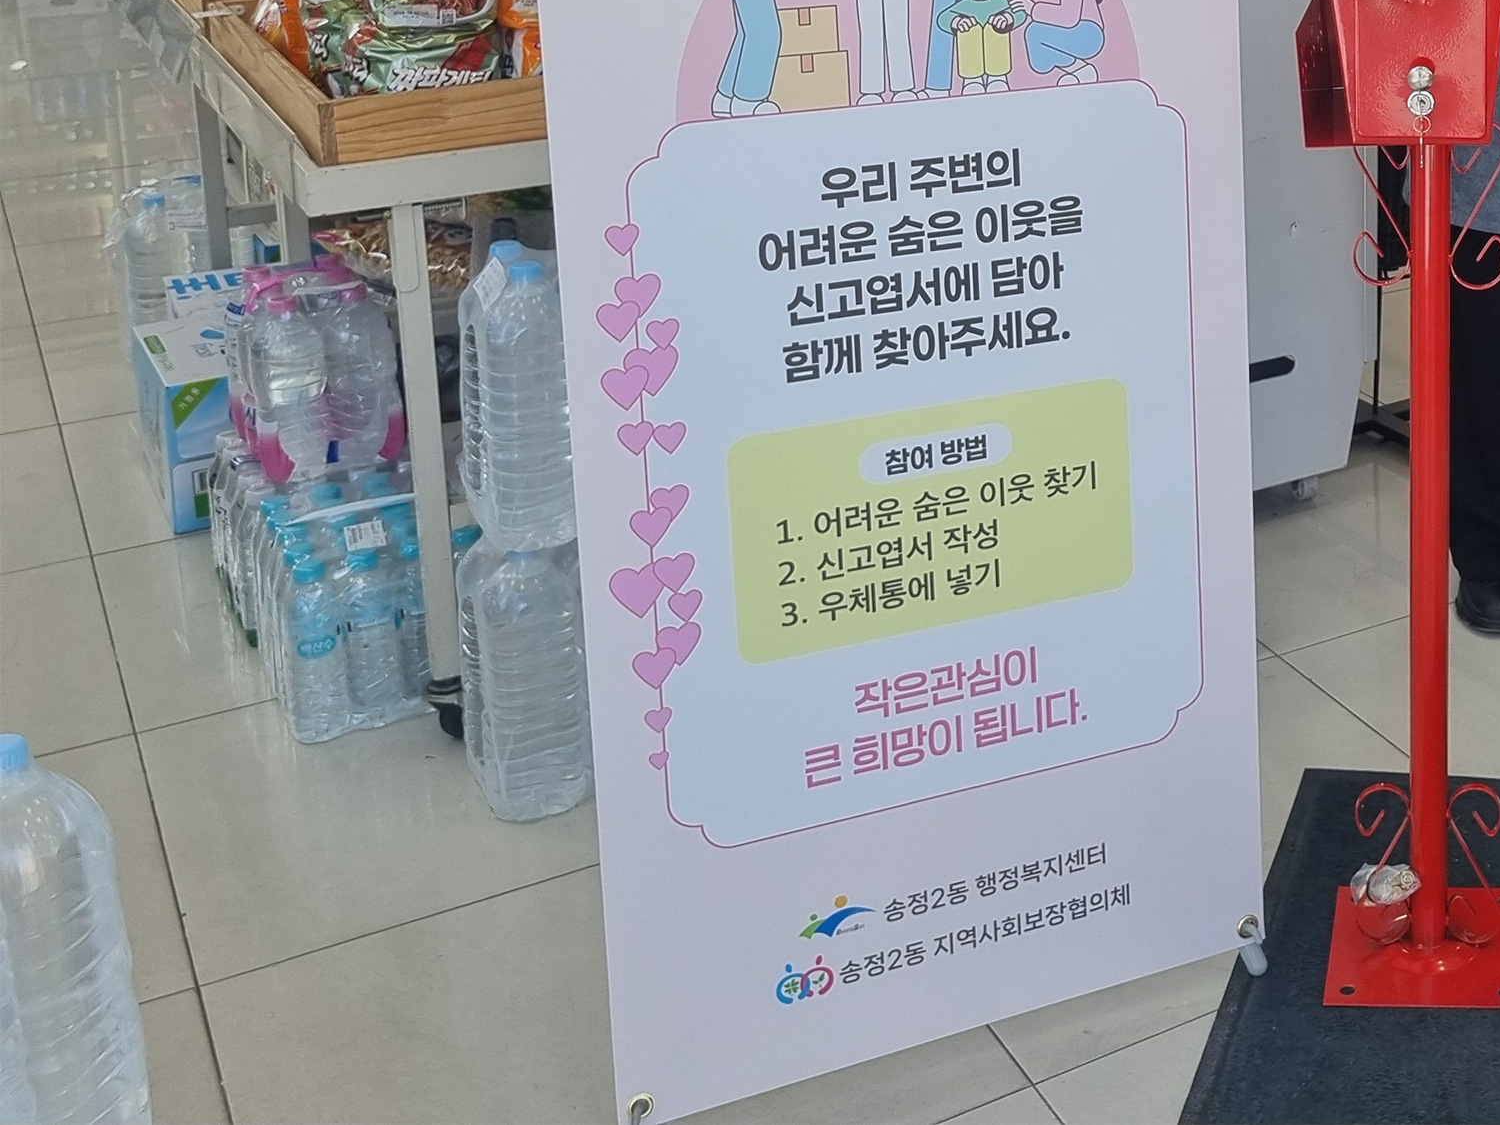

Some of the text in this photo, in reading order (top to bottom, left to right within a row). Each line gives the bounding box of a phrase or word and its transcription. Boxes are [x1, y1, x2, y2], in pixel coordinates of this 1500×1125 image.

[820, 147, 1023, 208] 우리 주변의
[758, 195, 1084, 272] 어려운 숨은 이웃을
[785, 251, 1065, 328] 신고엽서에 담아
[782, 305, 1072, 384] 함께 찾아주세요.
[884, 432, 988, 475] 참여 방법
[775, 459, 1099, 546] 1. 어려운 숨은 이웃 찾기
[777, 519, 1001, 587] 2. 신고엽서 작성
[780, 557, 1002, 628] 3. 우체통에 넣기
[853, 646, 1040, 719] 작은관심이
[803, 689, 1089, 789] 큰 희망이 됩니다.
[883, 842, 1108, 924] 송정2동 행정복지센터
[838, 883, 1132, 986] 송정2동 지역사회보장협의체
